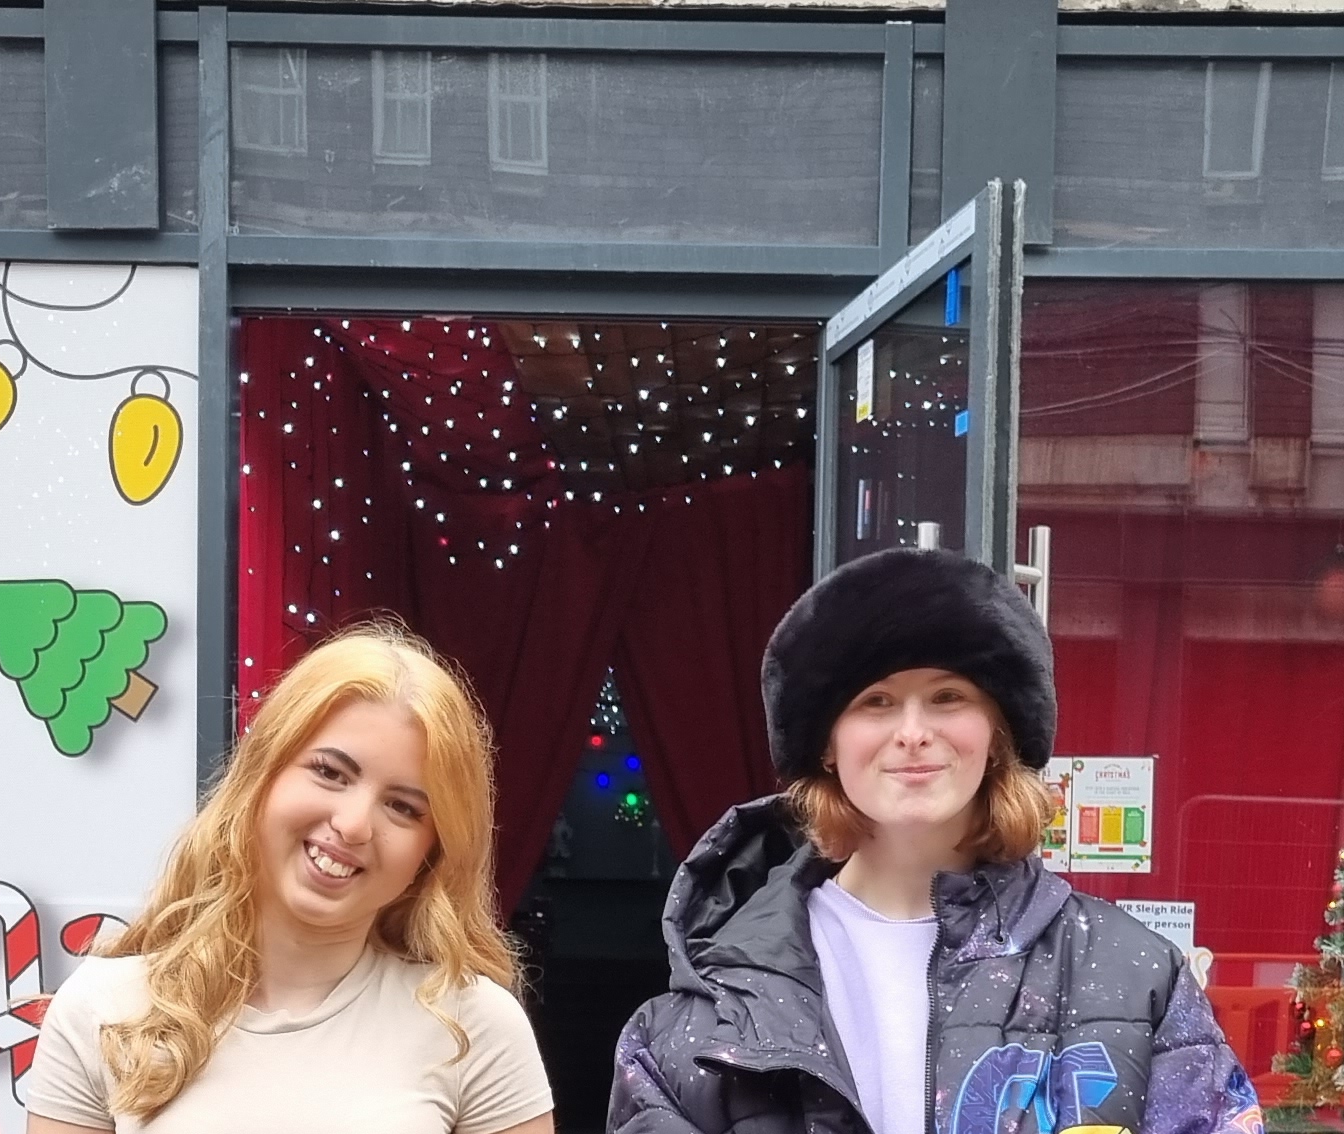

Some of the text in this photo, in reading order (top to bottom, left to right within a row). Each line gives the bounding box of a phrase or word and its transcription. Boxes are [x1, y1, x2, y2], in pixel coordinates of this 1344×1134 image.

[1136, 904, 1167, 916] Sleigh
[1170, 905, 1193, 915] Ride
[1154, 921, 1191, 930] person
